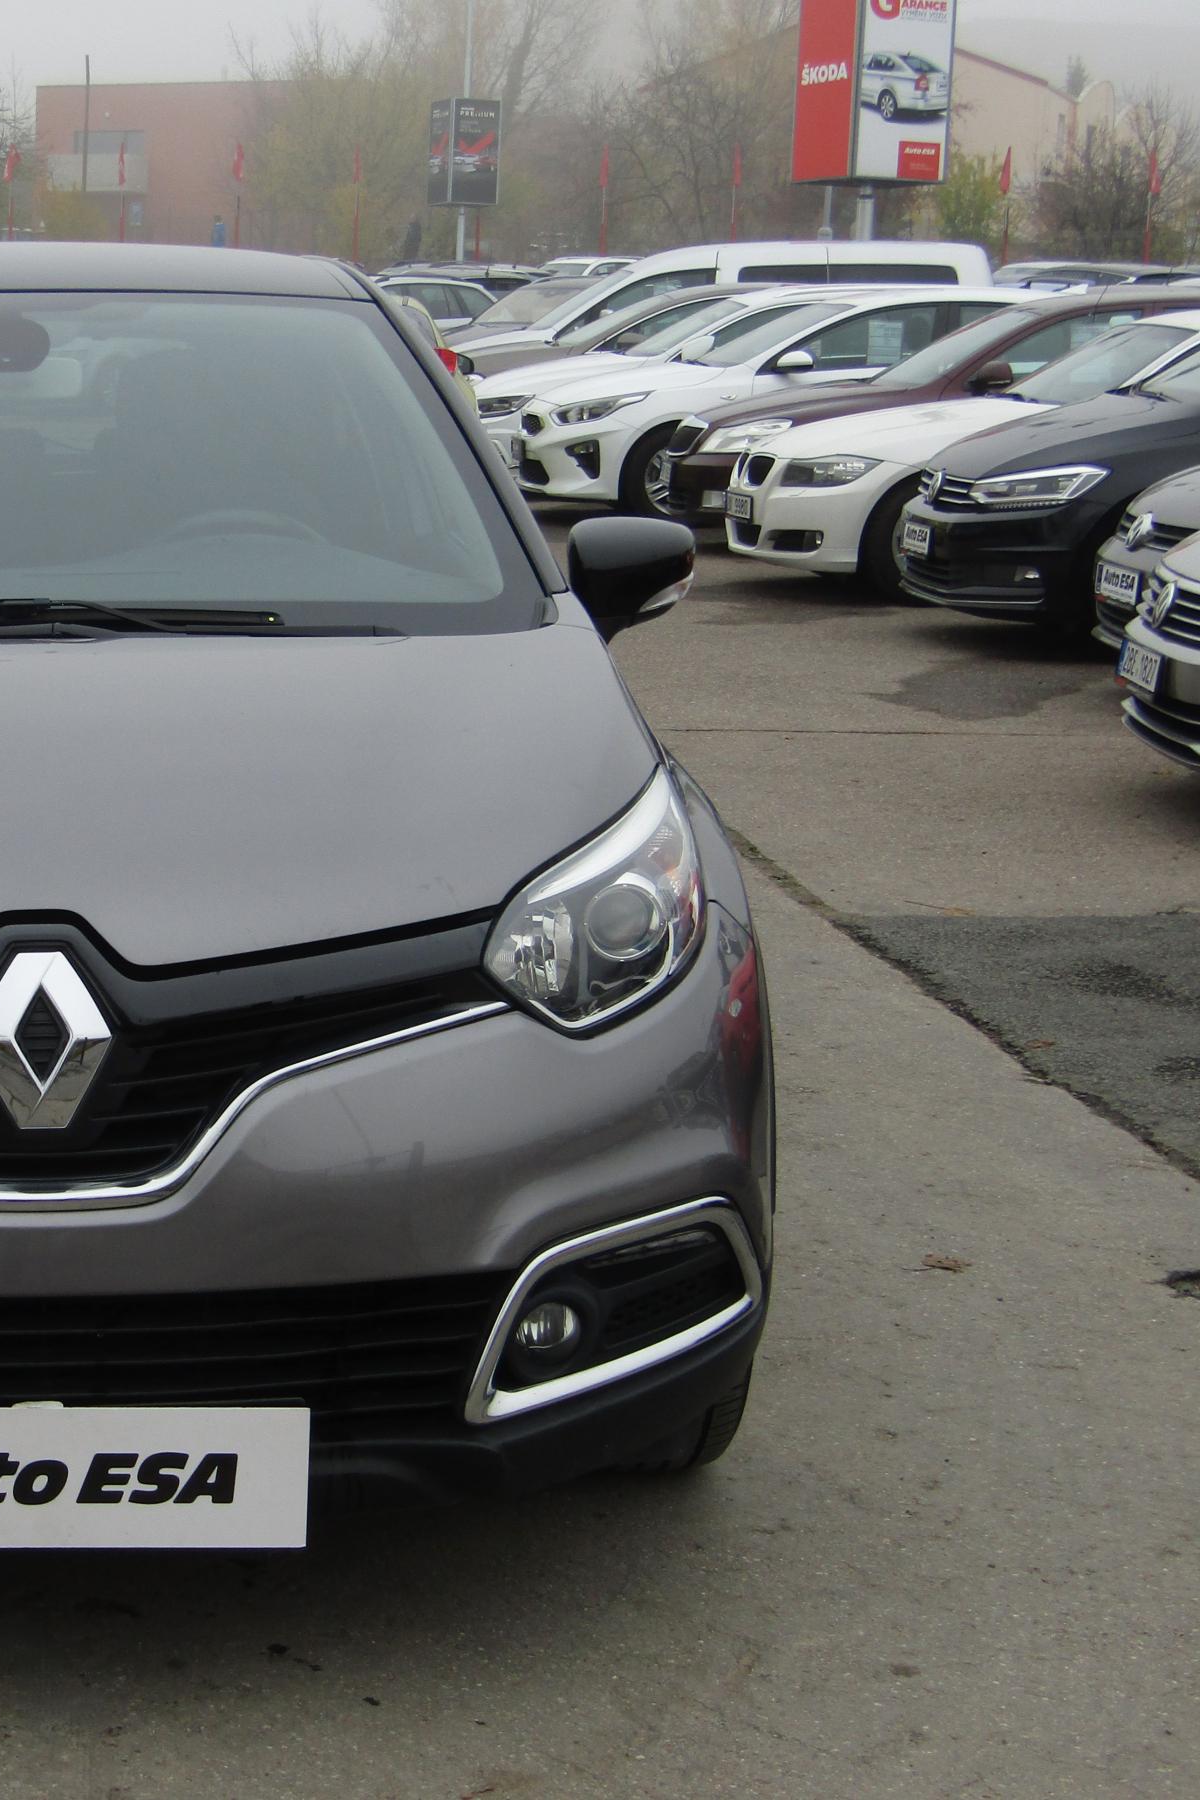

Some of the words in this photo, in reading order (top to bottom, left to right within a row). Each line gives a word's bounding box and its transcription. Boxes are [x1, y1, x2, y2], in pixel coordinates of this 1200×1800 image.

[801, 63, 848, 86] ŠKODA
[1103, 568, 1120, 588] Auto
[1119, 573, 1136, 592] ESA
[76, 1452, 238, 1504] ESA
